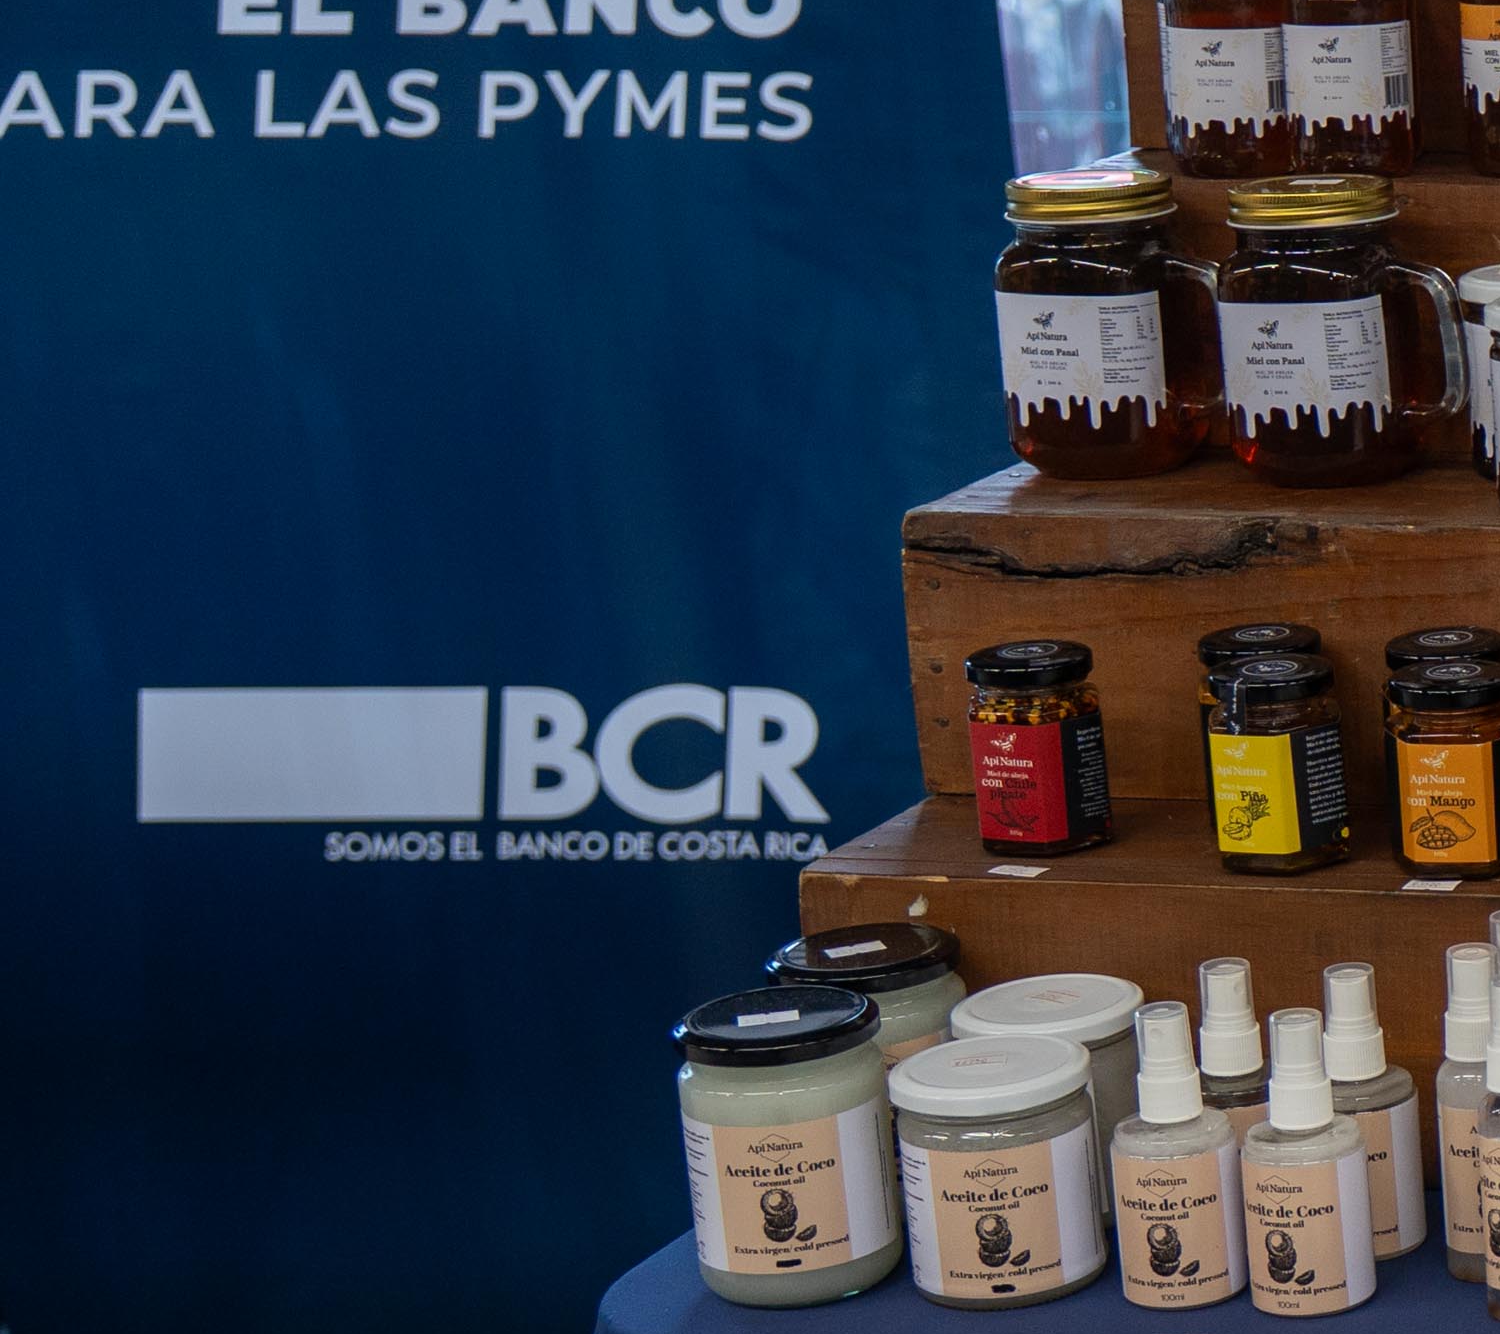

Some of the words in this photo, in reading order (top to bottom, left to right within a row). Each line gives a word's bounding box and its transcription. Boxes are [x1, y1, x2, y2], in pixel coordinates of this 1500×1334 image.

[0, 69, 213, 139] ARA
[253, 69, 441, 140] LAS
[477, 69, 814, 141] PYMES
[498, 683, 831, 824] BCR
[1240, 790, 1268, 803] Piña
[1430, 796, 1476, 810] Mango
[324, 831, 445, 863] SOMOS
[449, 832, 483, 862] EL
[496, 832, 609, 863] BANCO
[612, 832, 654, 863] DE
[657, 832, 760, 863] COSTA
[763, 832, 829, 863] RICA
[747, 1143, 765, 1154] Api
[766, 1141, 803, 1151] Natura
[725, 1164, 771, 1178] Aceite
[774, 1164, 793, 1176] de
[797, 1157, 835, 1173] Coco
[753, 1178, 791, 1188] Coconut
[794, 1175, 805, 1185] oil
[941, 1189, 986, 1203] Aceite
[989, 1187, 1008, 1201] de
[1011, 1182, 1049, 1198] Coco
